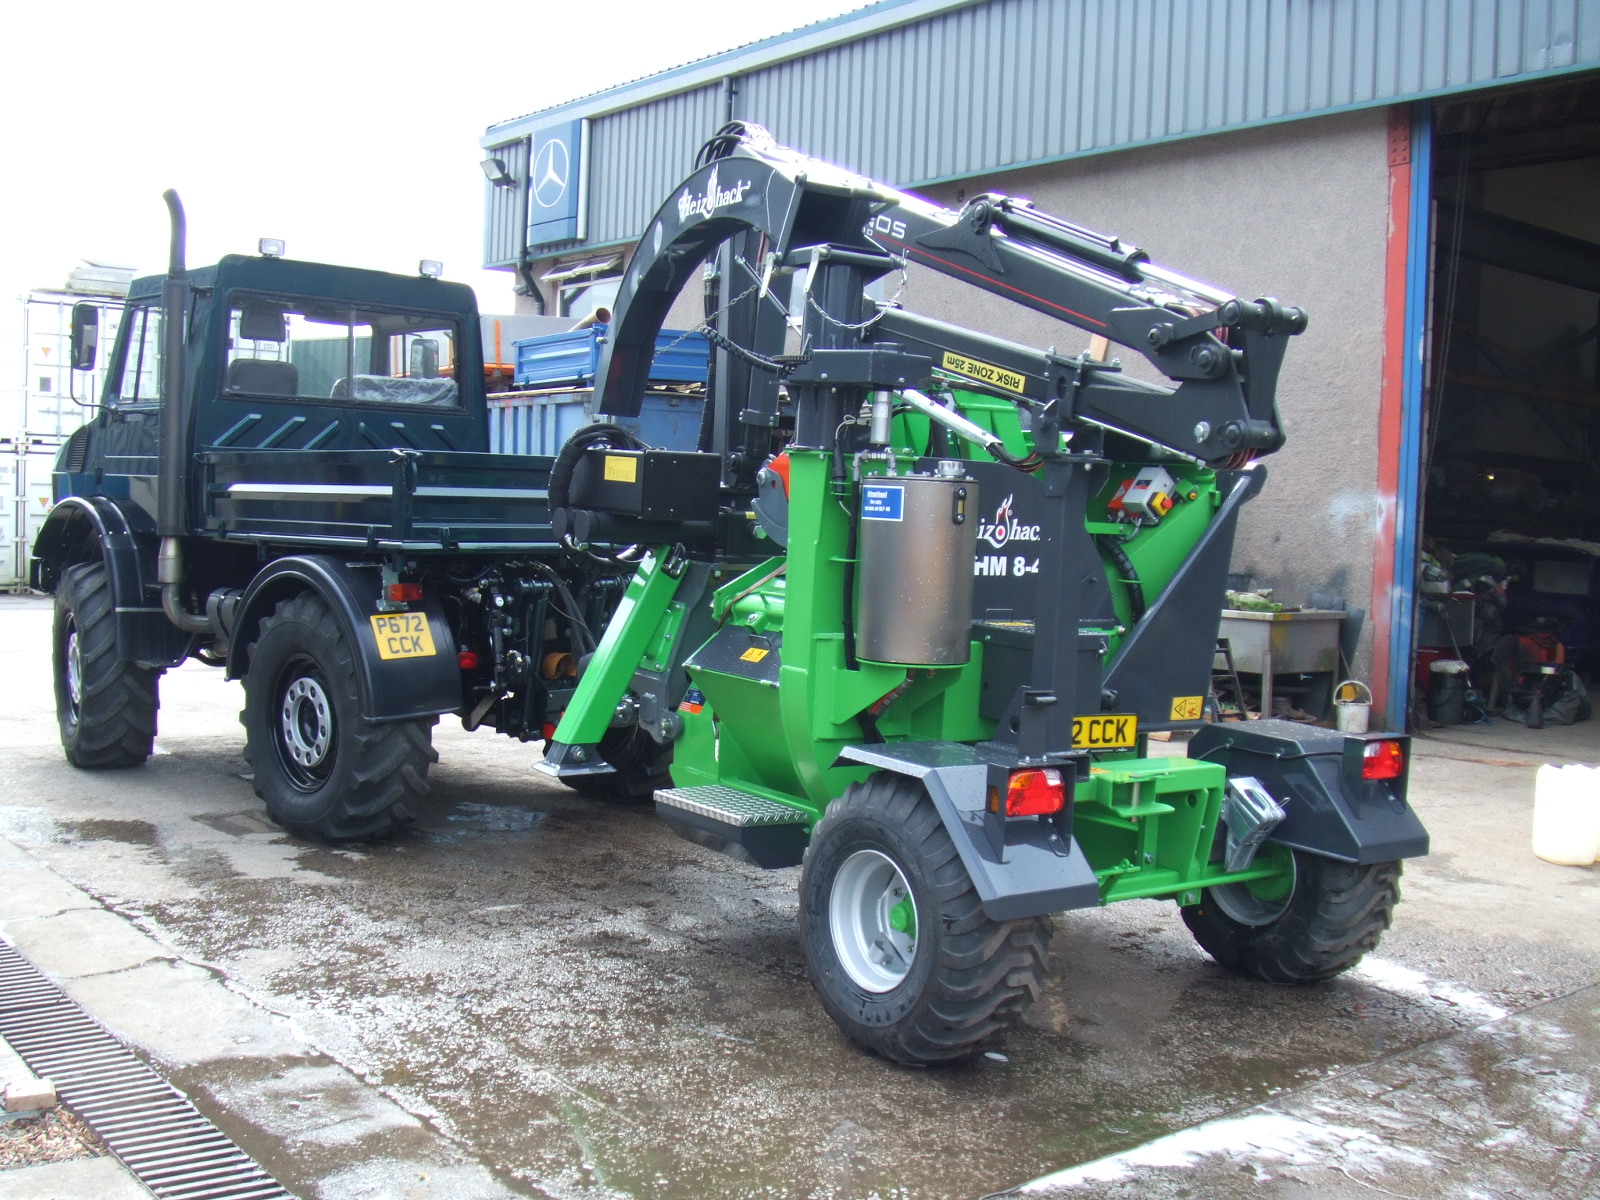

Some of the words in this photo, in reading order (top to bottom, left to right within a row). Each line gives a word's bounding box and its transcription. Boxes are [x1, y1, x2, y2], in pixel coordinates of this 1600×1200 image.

[870, 214, 907, 239] OS
[947, 355, 965, 370] 25m
[967, 362, 994, 380] ZONE
[996, 372, 1020, 388] RISK
[375, 616, 424, 634] P672
[387, 636, 424, 654] CCK
[1089, 719, 1128, 744] CCK
